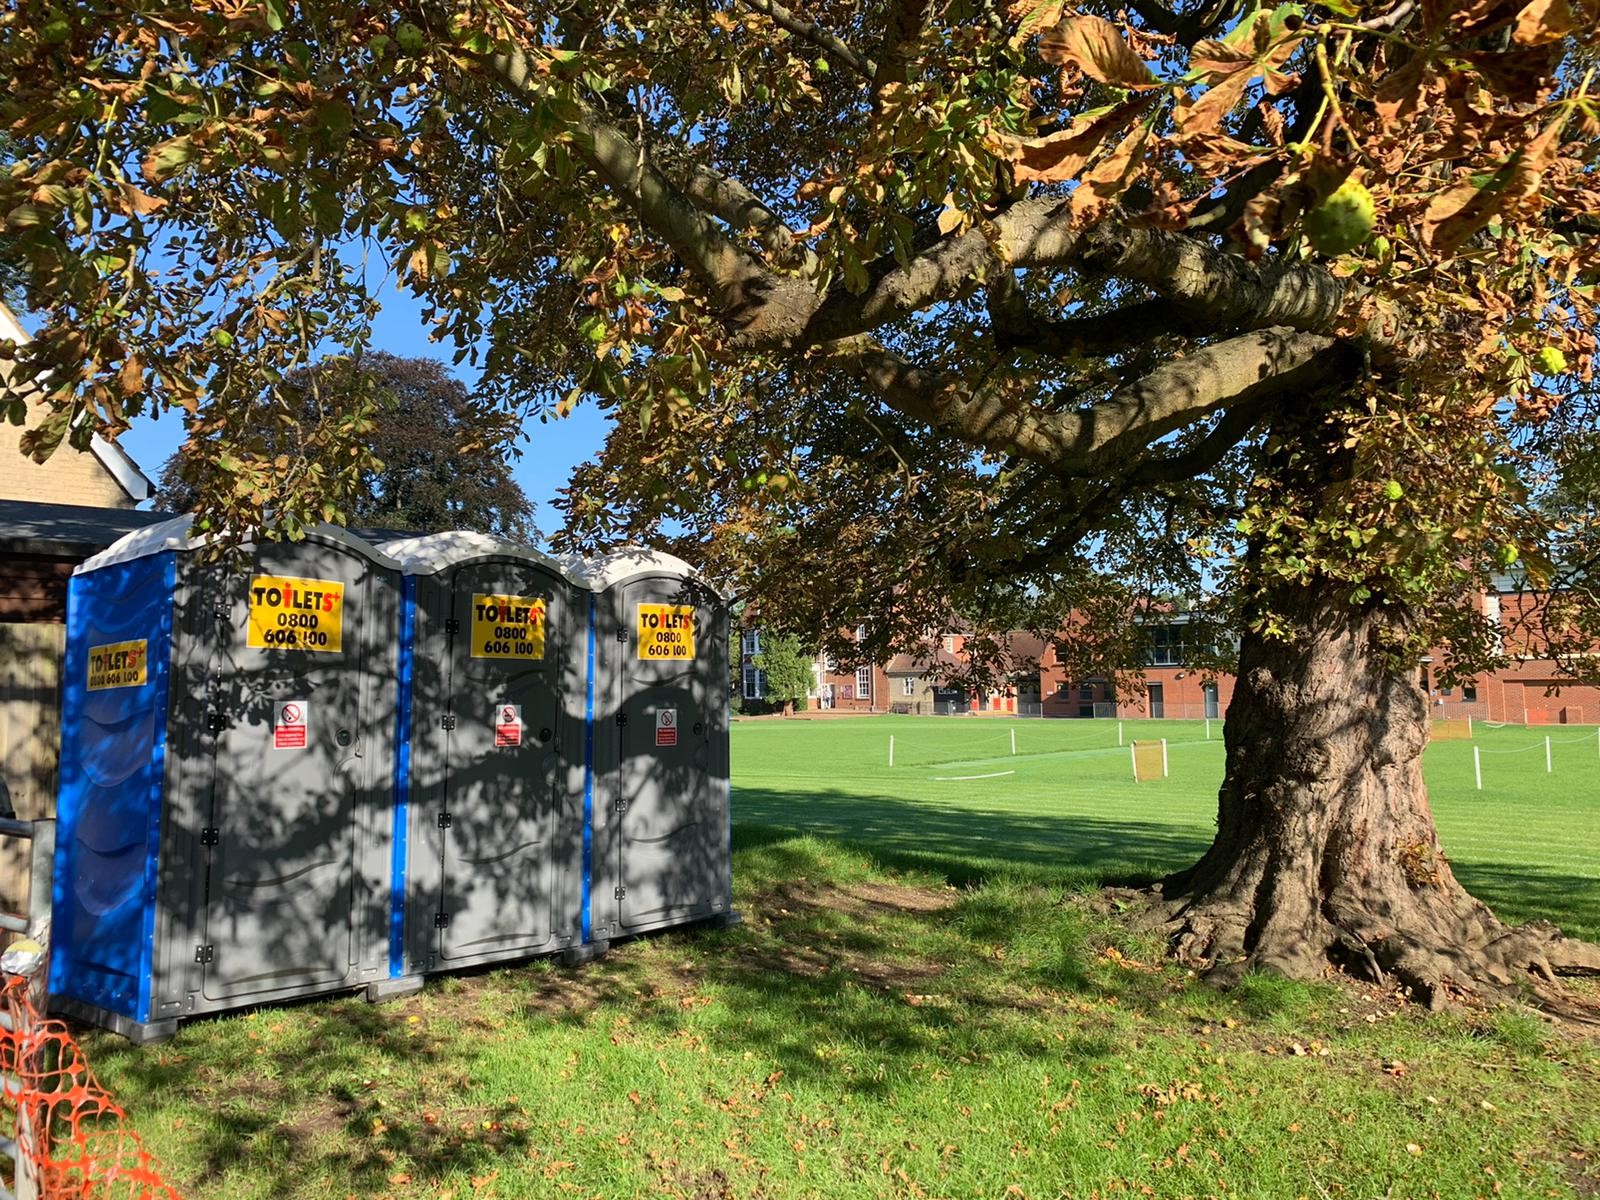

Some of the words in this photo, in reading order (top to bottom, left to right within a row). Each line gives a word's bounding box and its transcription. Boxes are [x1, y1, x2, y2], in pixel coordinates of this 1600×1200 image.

[277, 613, 319, 629] 0800
[264, 629, 297, 645] 606
[303, 631, 327, 646] 100
[494, 626, 527, 640] 0800
[656, 632, 681, 643] 0800
[484, 641, 510, 654] 606
[514, 642, 533, 655] 100
[648, 645, 669, 656] 606
[673, 645, 687, 656] 100
[106, 671, 120, 685] 606
[123, 671, 138, 683] 100
